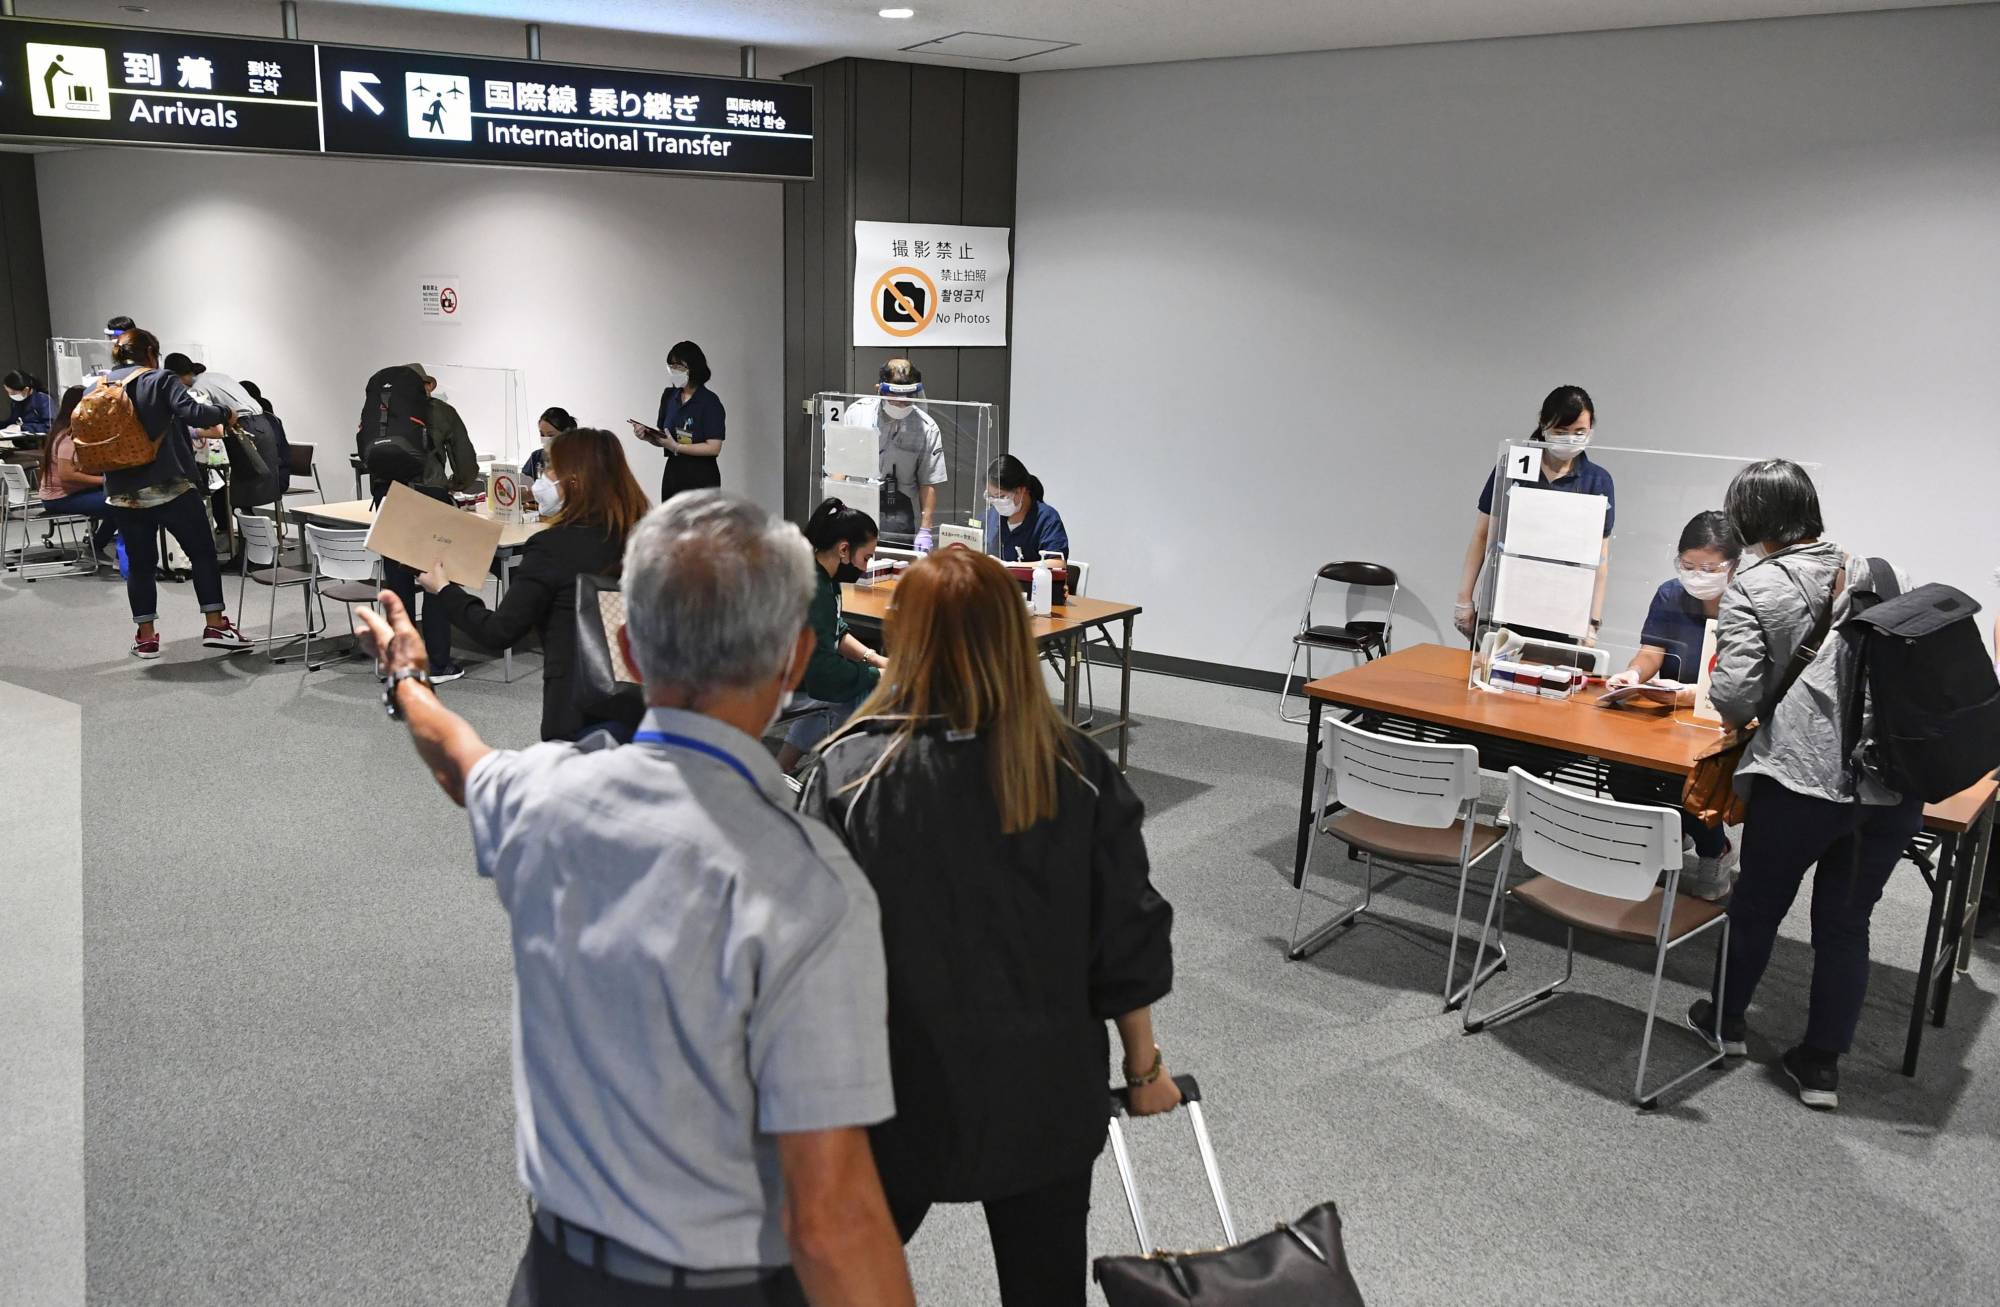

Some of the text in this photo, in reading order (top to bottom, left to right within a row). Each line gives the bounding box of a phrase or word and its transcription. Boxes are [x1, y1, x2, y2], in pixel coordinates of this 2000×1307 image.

[248, 79, 280, 96] 도착
[483, 79, 578, 114] 国際線
[129, 98, 239, 129] Arrivals
[487, 120, 732, 158] International Transfer
[941, 268, 987, 282] 禁止拍照
[941, 288, 985, 303] 촬영금지
[936, 312, 991, 324] No Photos
[830, 407, 840, 422] 2
[1517, 455, 1530, 474] 1
